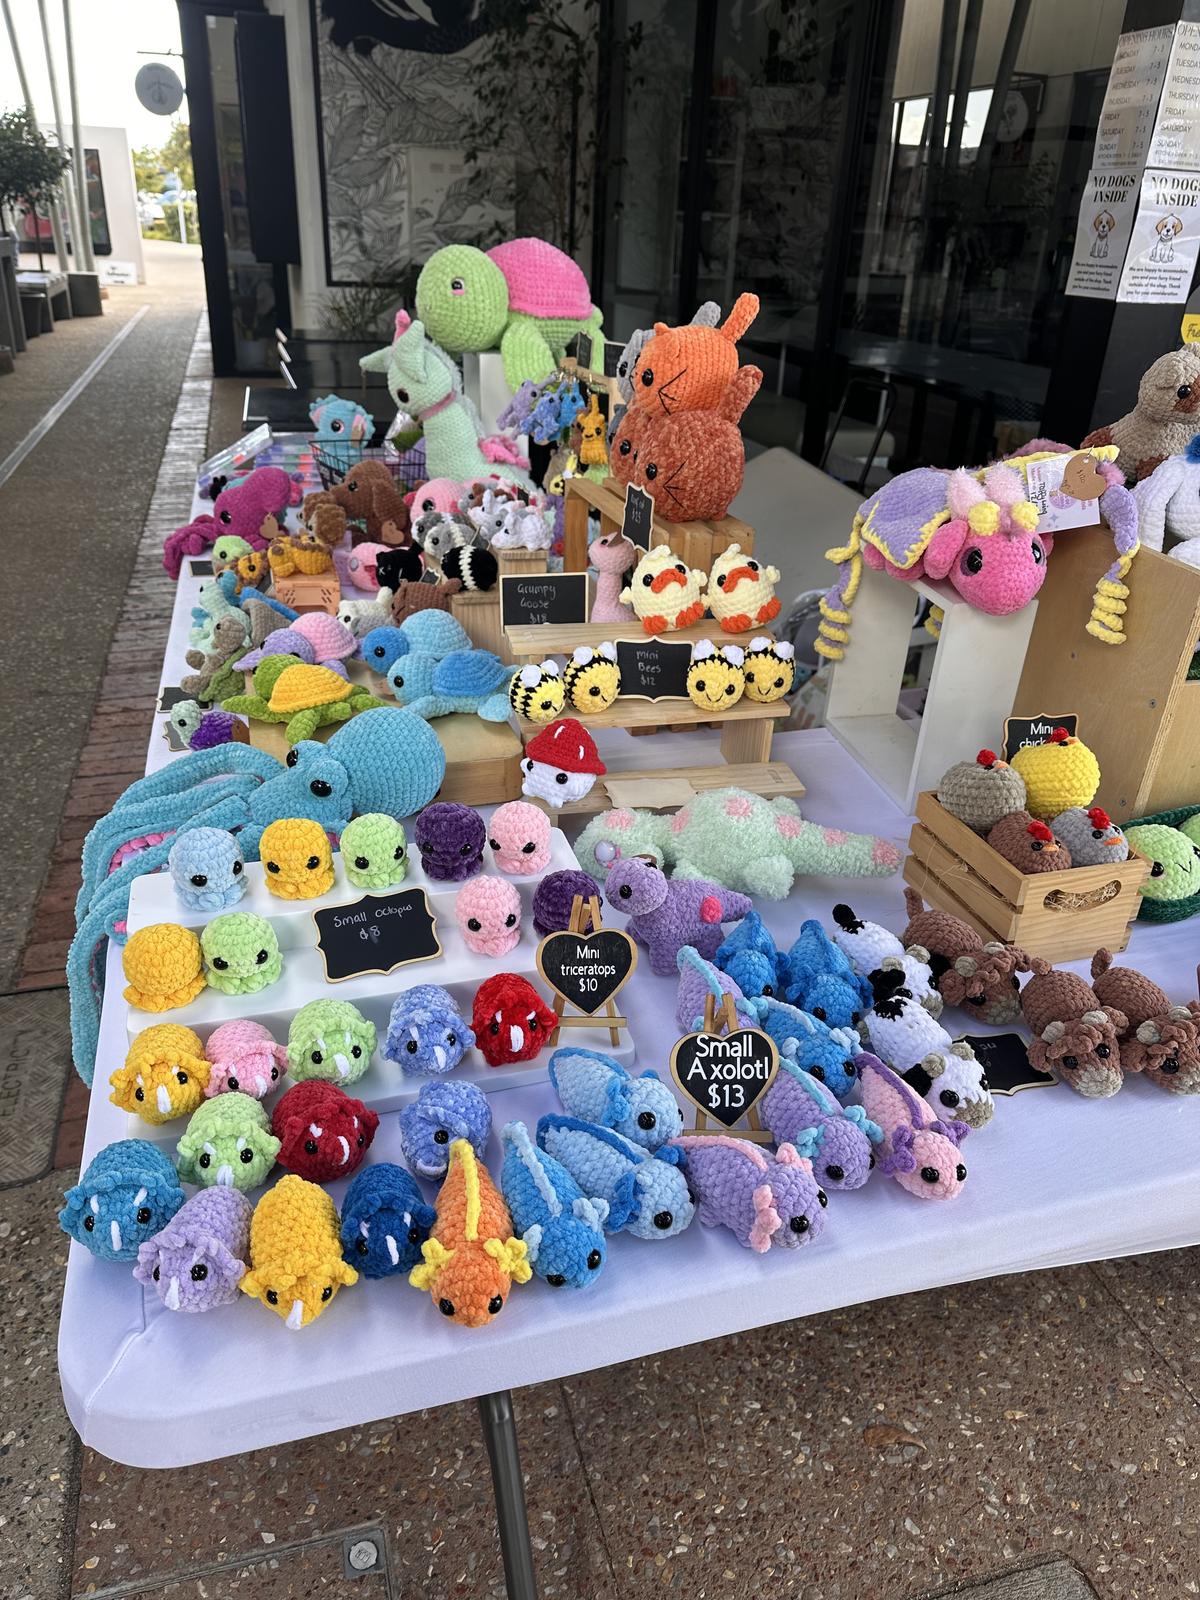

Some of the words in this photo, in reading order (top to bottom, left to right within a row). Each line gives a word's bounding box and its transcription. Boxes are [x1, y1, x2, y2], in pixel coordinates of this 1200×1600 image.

[1168, 91, 1199, 100] THURSDAY
[1165, 107, 1186, 116] FRIDAY
[1161, 122, 1192, 133] SATURDAY
[1094, 176, 1106, 188] NO
[1108, 174, 1137, 188] DOGS
[1152, 176, 1168, 190] NO
[1171, 177, 1200, 192] DOG
[1094, 190, 1128, 202] INSIDE
[1156, 193, 1198, 208] INSIDE
[517, 583, 556, 601] Grumpy
[520, 597, 550, 609] Goose
[638, 662, 662, 674] Bees
[640, 674, 656, 686] $12
[1030, 722, 1054, 736] Mini
[1019, 737, 1047, 749] chick
[333, 911, 368, 928] Small
[359, 925, 381, 940] $8
[576, 944, 600, 960] Mini
[560, 963, 616, 978] triceratops
[579, 978, 598, 993] $10
[696, 1034, 753, 1058] Small
[708, 1082, 745, 1108] $13
